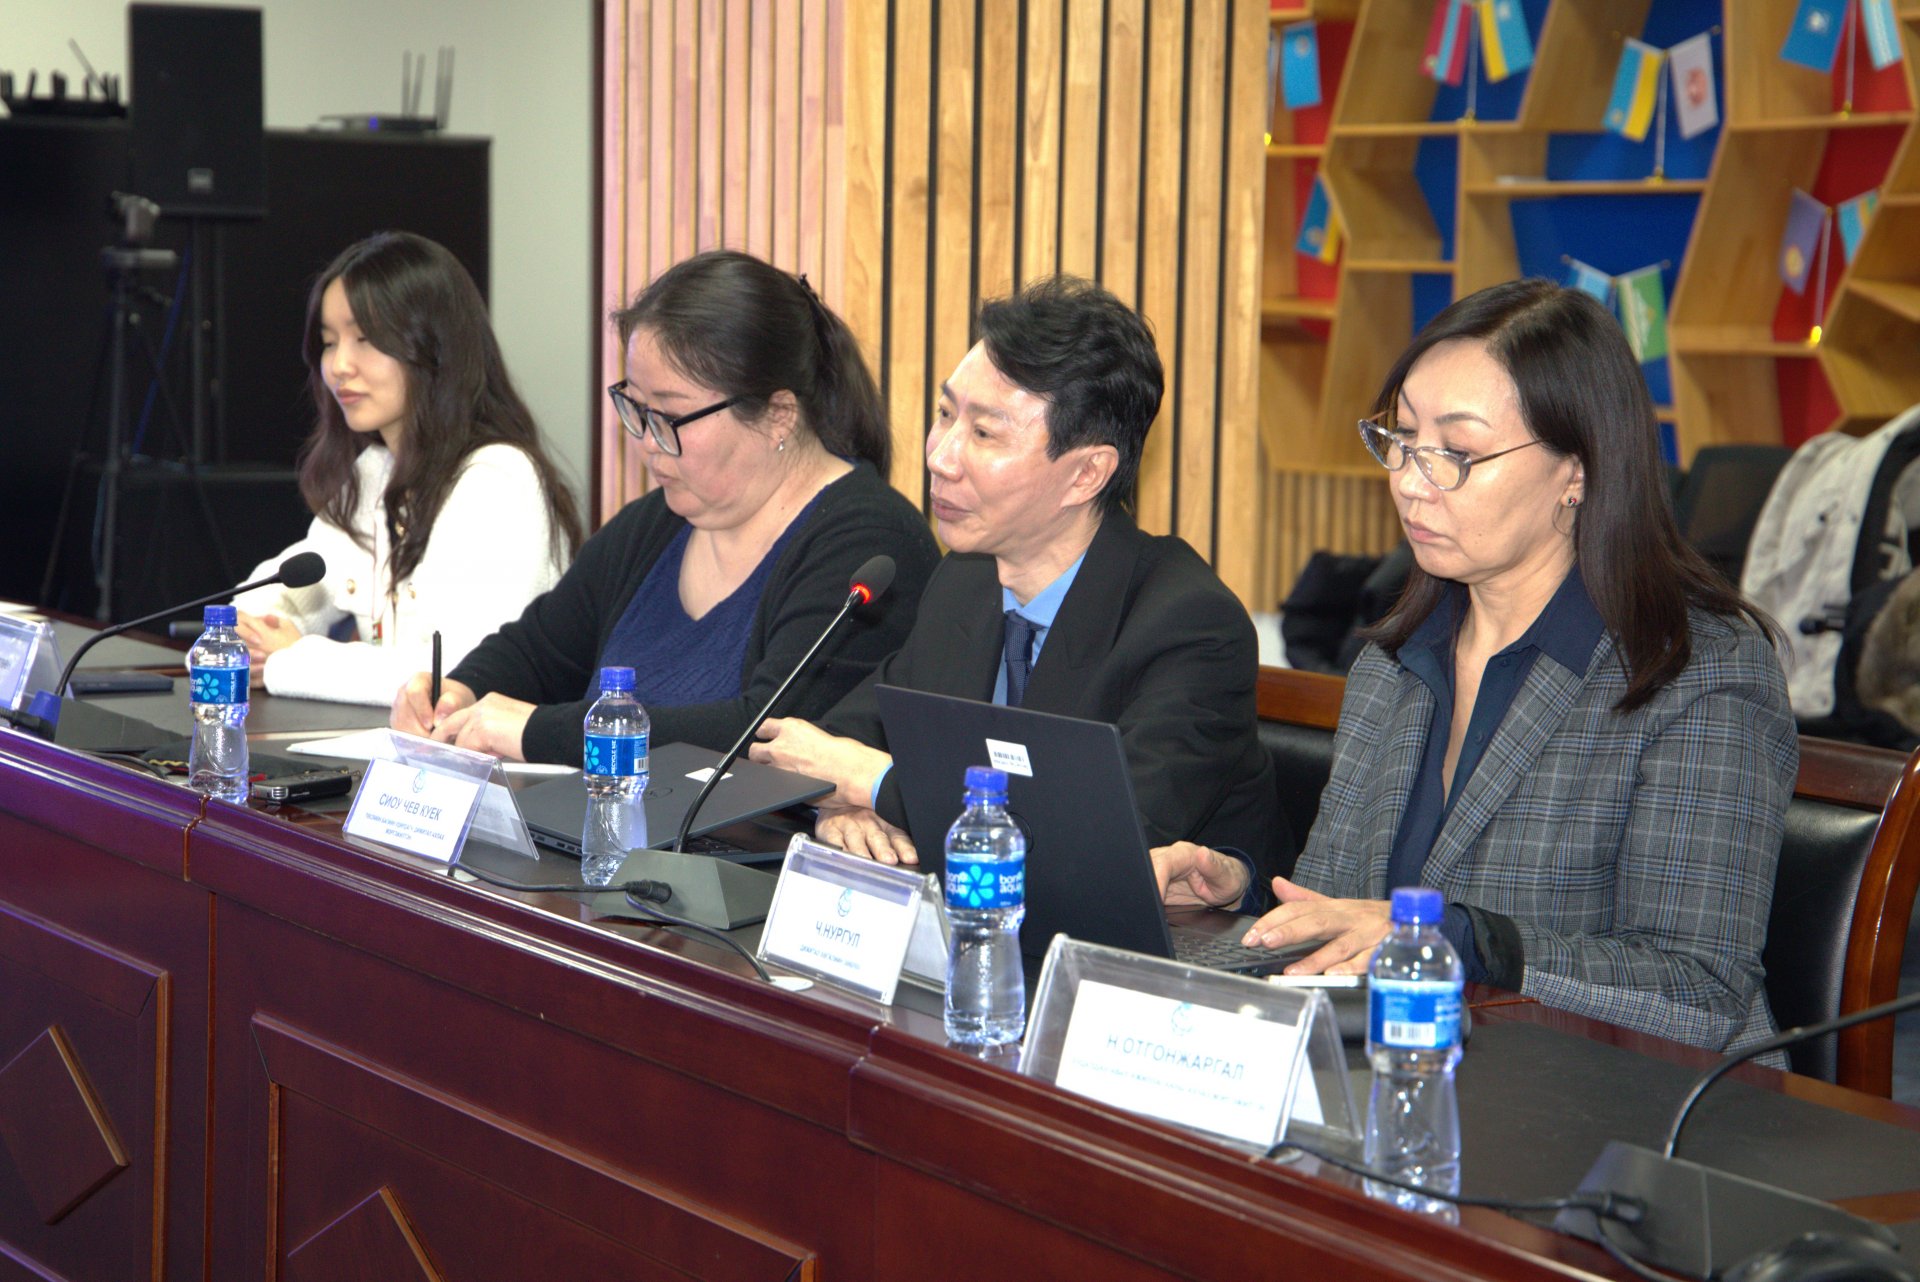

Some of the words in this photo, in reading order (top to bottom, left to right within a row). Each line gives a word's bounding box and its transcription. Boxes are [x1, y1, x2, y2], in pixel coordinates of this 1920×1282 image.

[379, 793, 402, 809] СИОУ
[403, 800, 420, 814] ЧЕВ
[420, 805, 443, 821] КУЕК
[1106, 1034, 1244, 1080] НОТГОНЖАРГАЛ
